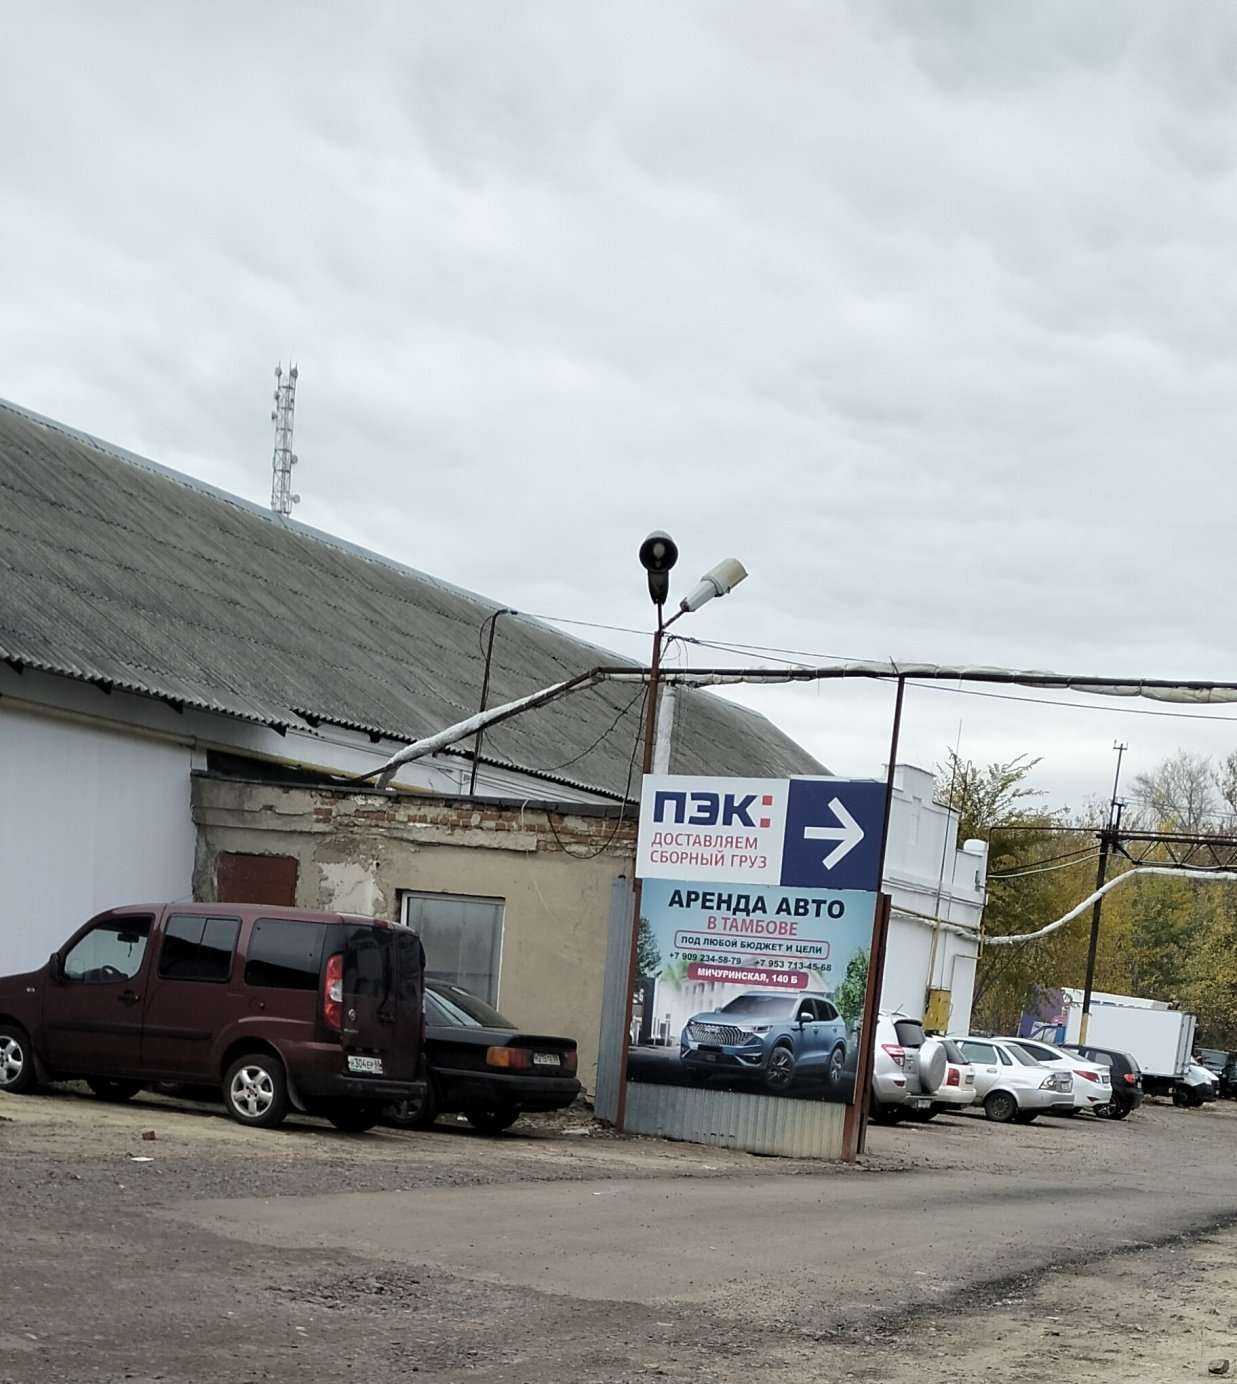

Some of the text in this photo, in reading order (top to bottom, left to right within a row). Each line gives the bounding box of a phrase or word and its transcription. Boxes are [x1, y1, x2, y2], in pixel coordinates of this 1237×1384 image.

[651, 832, 758, 850] ДОСТАВЛЯЕМ
[650, 850, 768, 869] СБОРНЫЙ ГРУЗ
[668, 889, 846, 919] АРЕНДА АВТО
[707, 915, 798, 937] В ТАМБОВЕ
[681, 936, 823, 955] ПОД ЛЮБОЙ БЮДЖЕТ И ЦЕЛИ
[669, 952, 680, 960] +7
[682, 952, 698, 961] 909
[755, 959, 766, 967] +7
[768, 959, 785, 968] 953
[697, 967, 798, 984] МИЧУРИНСКАЯ, 140 Б
